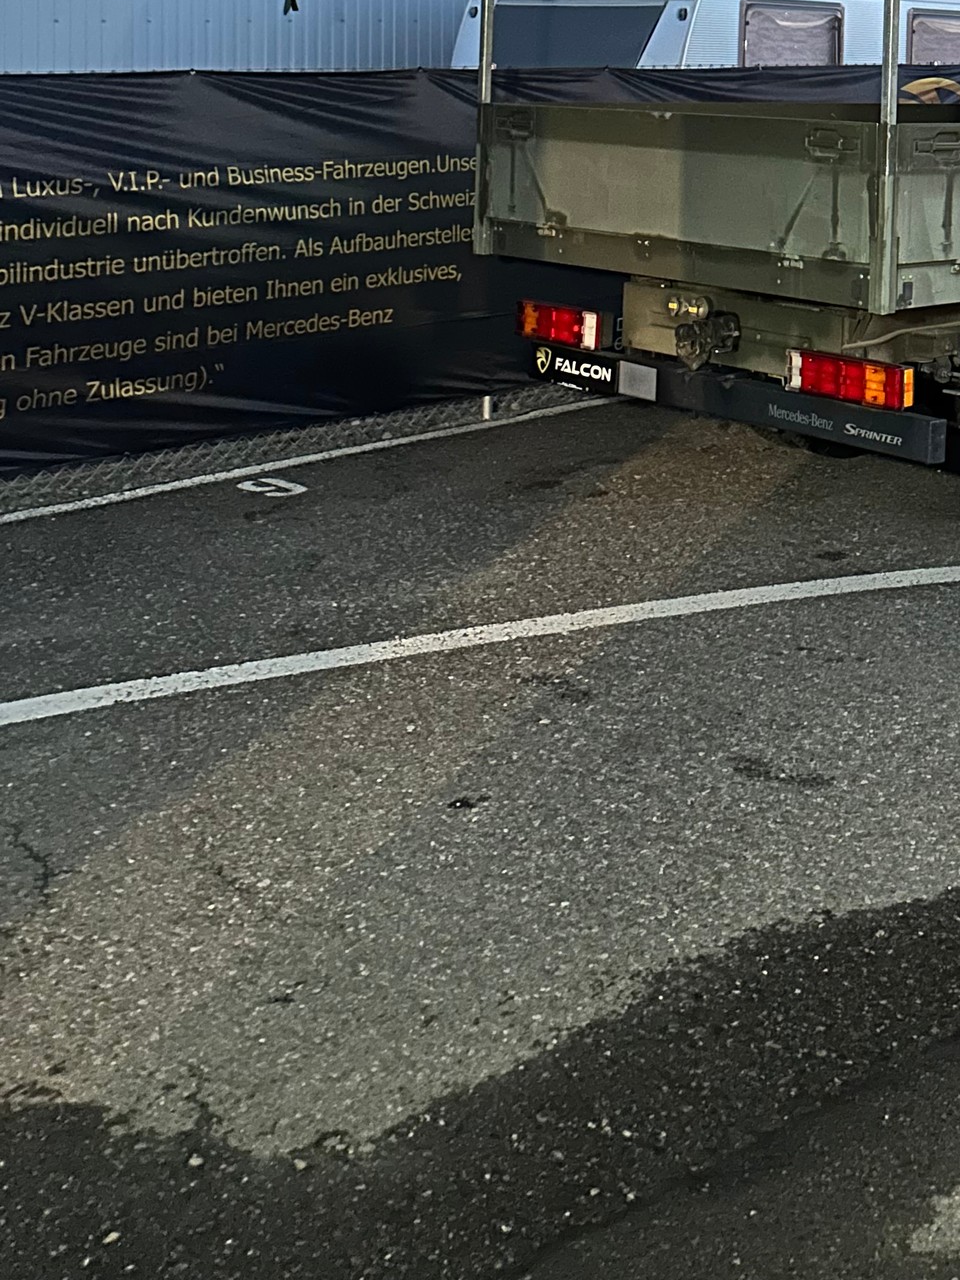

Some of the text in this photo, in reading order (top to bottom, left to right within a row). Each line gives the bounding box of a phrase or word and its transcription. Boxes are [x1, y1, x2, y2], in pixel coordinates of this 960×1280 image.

[12, 177, 99, 198] Luxus-,
[107, 170, 171, 192] V.I.P.-
[179, 167, 219, 189] und
[0, 212, 118, 241] individuell
[127, 209, 179, 232] nach
[188, 198, 341, 228] Kundenwunsch
[349, 197, 365, 216] in
[372, 194, 402, 215] der
[133, 242, 286, 274] unübertroffen.
[294, 237, 324, 259] Als
[20, 299, 134, 326] V-Klassen
[143, 289, 185, 313] und
[193, 285, 257, 308] bieten
[266, 279, 324, 300] Ihnen
[330, 274, 359, 293] ein
[366, 264, 462, 289] exklusives,
[26, 338, 147, 368] Fahrzeuge
[155, 327, 199, 352] sind
[207, 323, 238, 346] bei
[246, 308, 394, 340] Mercedes-Benz
[555, 357, 612, 382] FALCON
[16, 388, 78, 412] ohne
[768, 403, 834, 431] Mercedes-Benz
